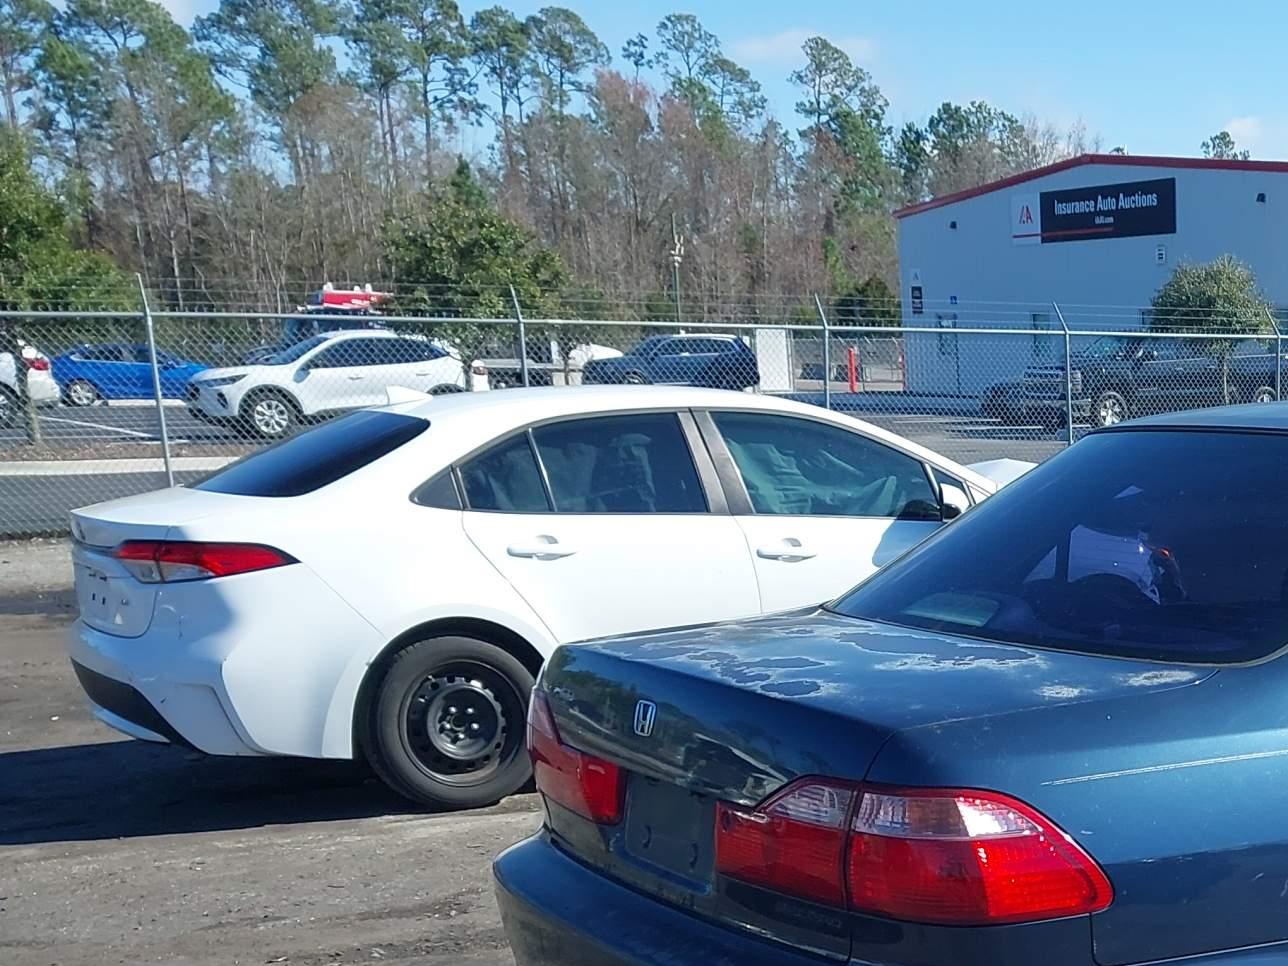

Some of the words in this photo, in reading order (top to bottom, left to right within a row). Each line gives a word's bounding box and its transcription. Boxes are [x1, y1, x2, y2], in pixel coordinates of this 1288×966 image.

[1054, 199, 1095, 216] Insurance
[1096, 194, 1117, 212] Auto
[1118, 192, 1158, 210] Auctions
